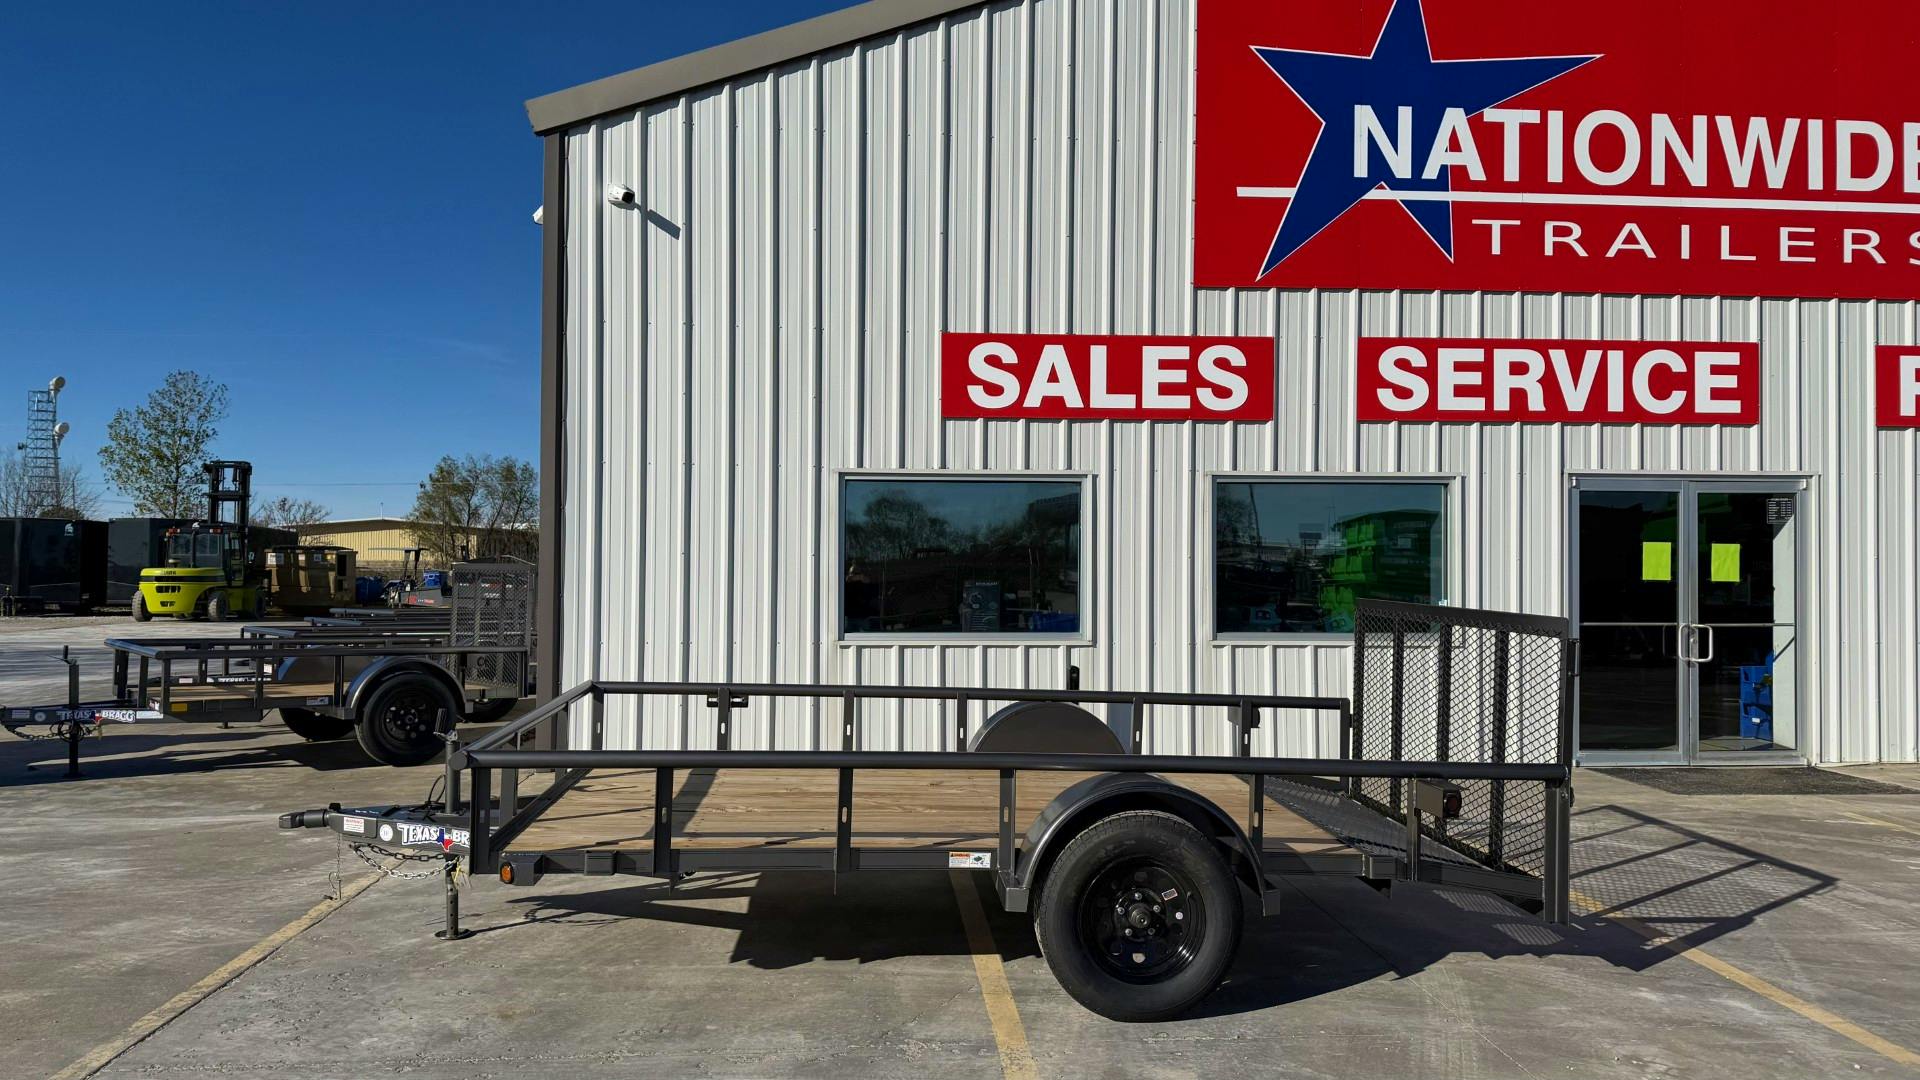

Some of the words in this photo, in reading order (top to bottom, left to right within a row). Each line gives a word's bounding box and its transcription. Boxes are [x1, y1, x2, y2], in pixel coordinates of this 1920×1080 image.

[1471, 218, 1920, 266] TRAILER
[966, 341, 1250, 412] SALES
[1376, 345, 1743, 415] SERVICE
[101, 710, 135, 723] BRAGG
[397, 823, 439, 845] TEXAS
